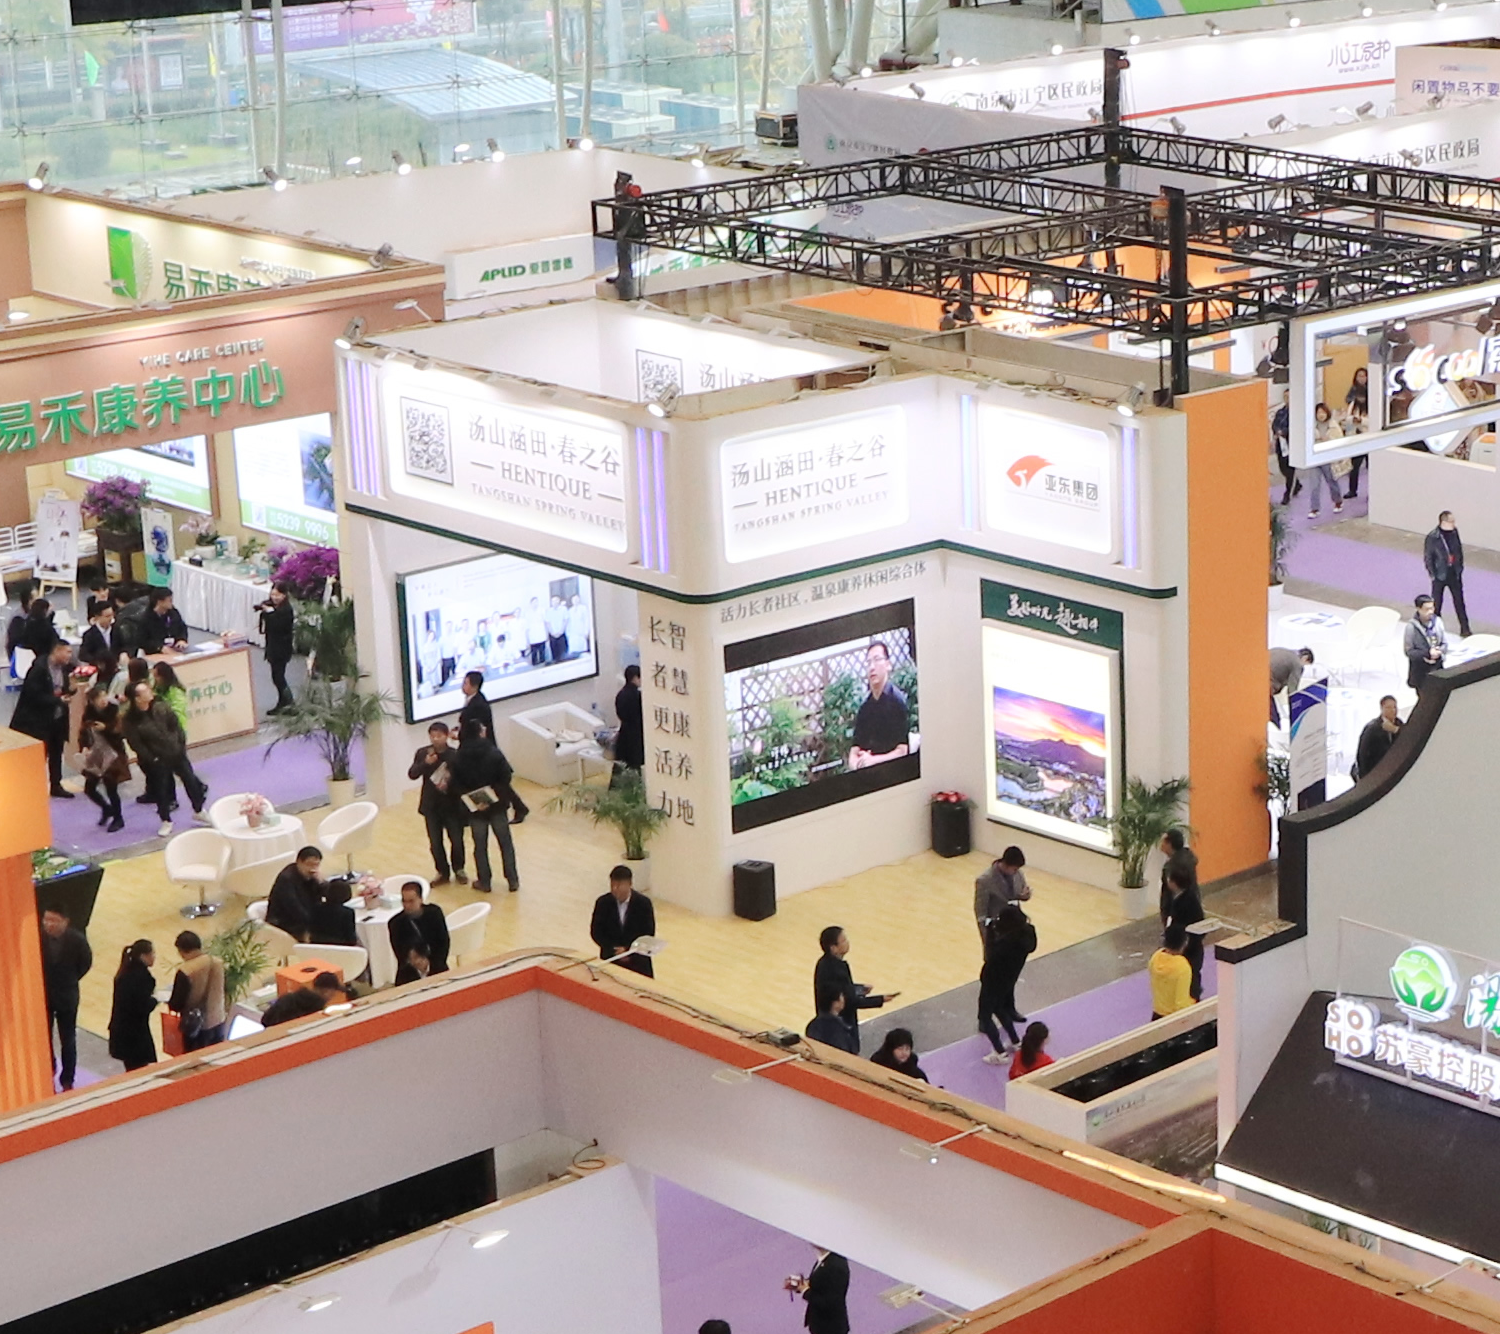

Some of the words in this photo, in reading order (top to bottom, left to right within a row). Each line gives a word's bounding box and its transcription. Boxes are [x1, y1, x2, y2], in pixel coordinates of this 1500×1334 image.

[216, 338, 265, 358] CENTER
[468, 412, 621, 478] 汤山涵田·春之谷
[730, 433, 887, 490] 汤山涵田·春之谷
[500, 460, 593, 501] HENTIQUE
[764, 471, 859, 508] HENTIQUE
[1044, 474, 1100, 502] 亚东集团
[470, 483, 530, 510] TANGSHAN
[535, 498, 577, 521] SPRING
[580, 509, 626, 533] VALLEY
[733, 510, 796, 534] TANGSHAN
[800, 499, 842, 520] SPRING
[846, 489, 890, 510] VALLEY
[1373, 1024, 1500, 1100] 苏豪控股
